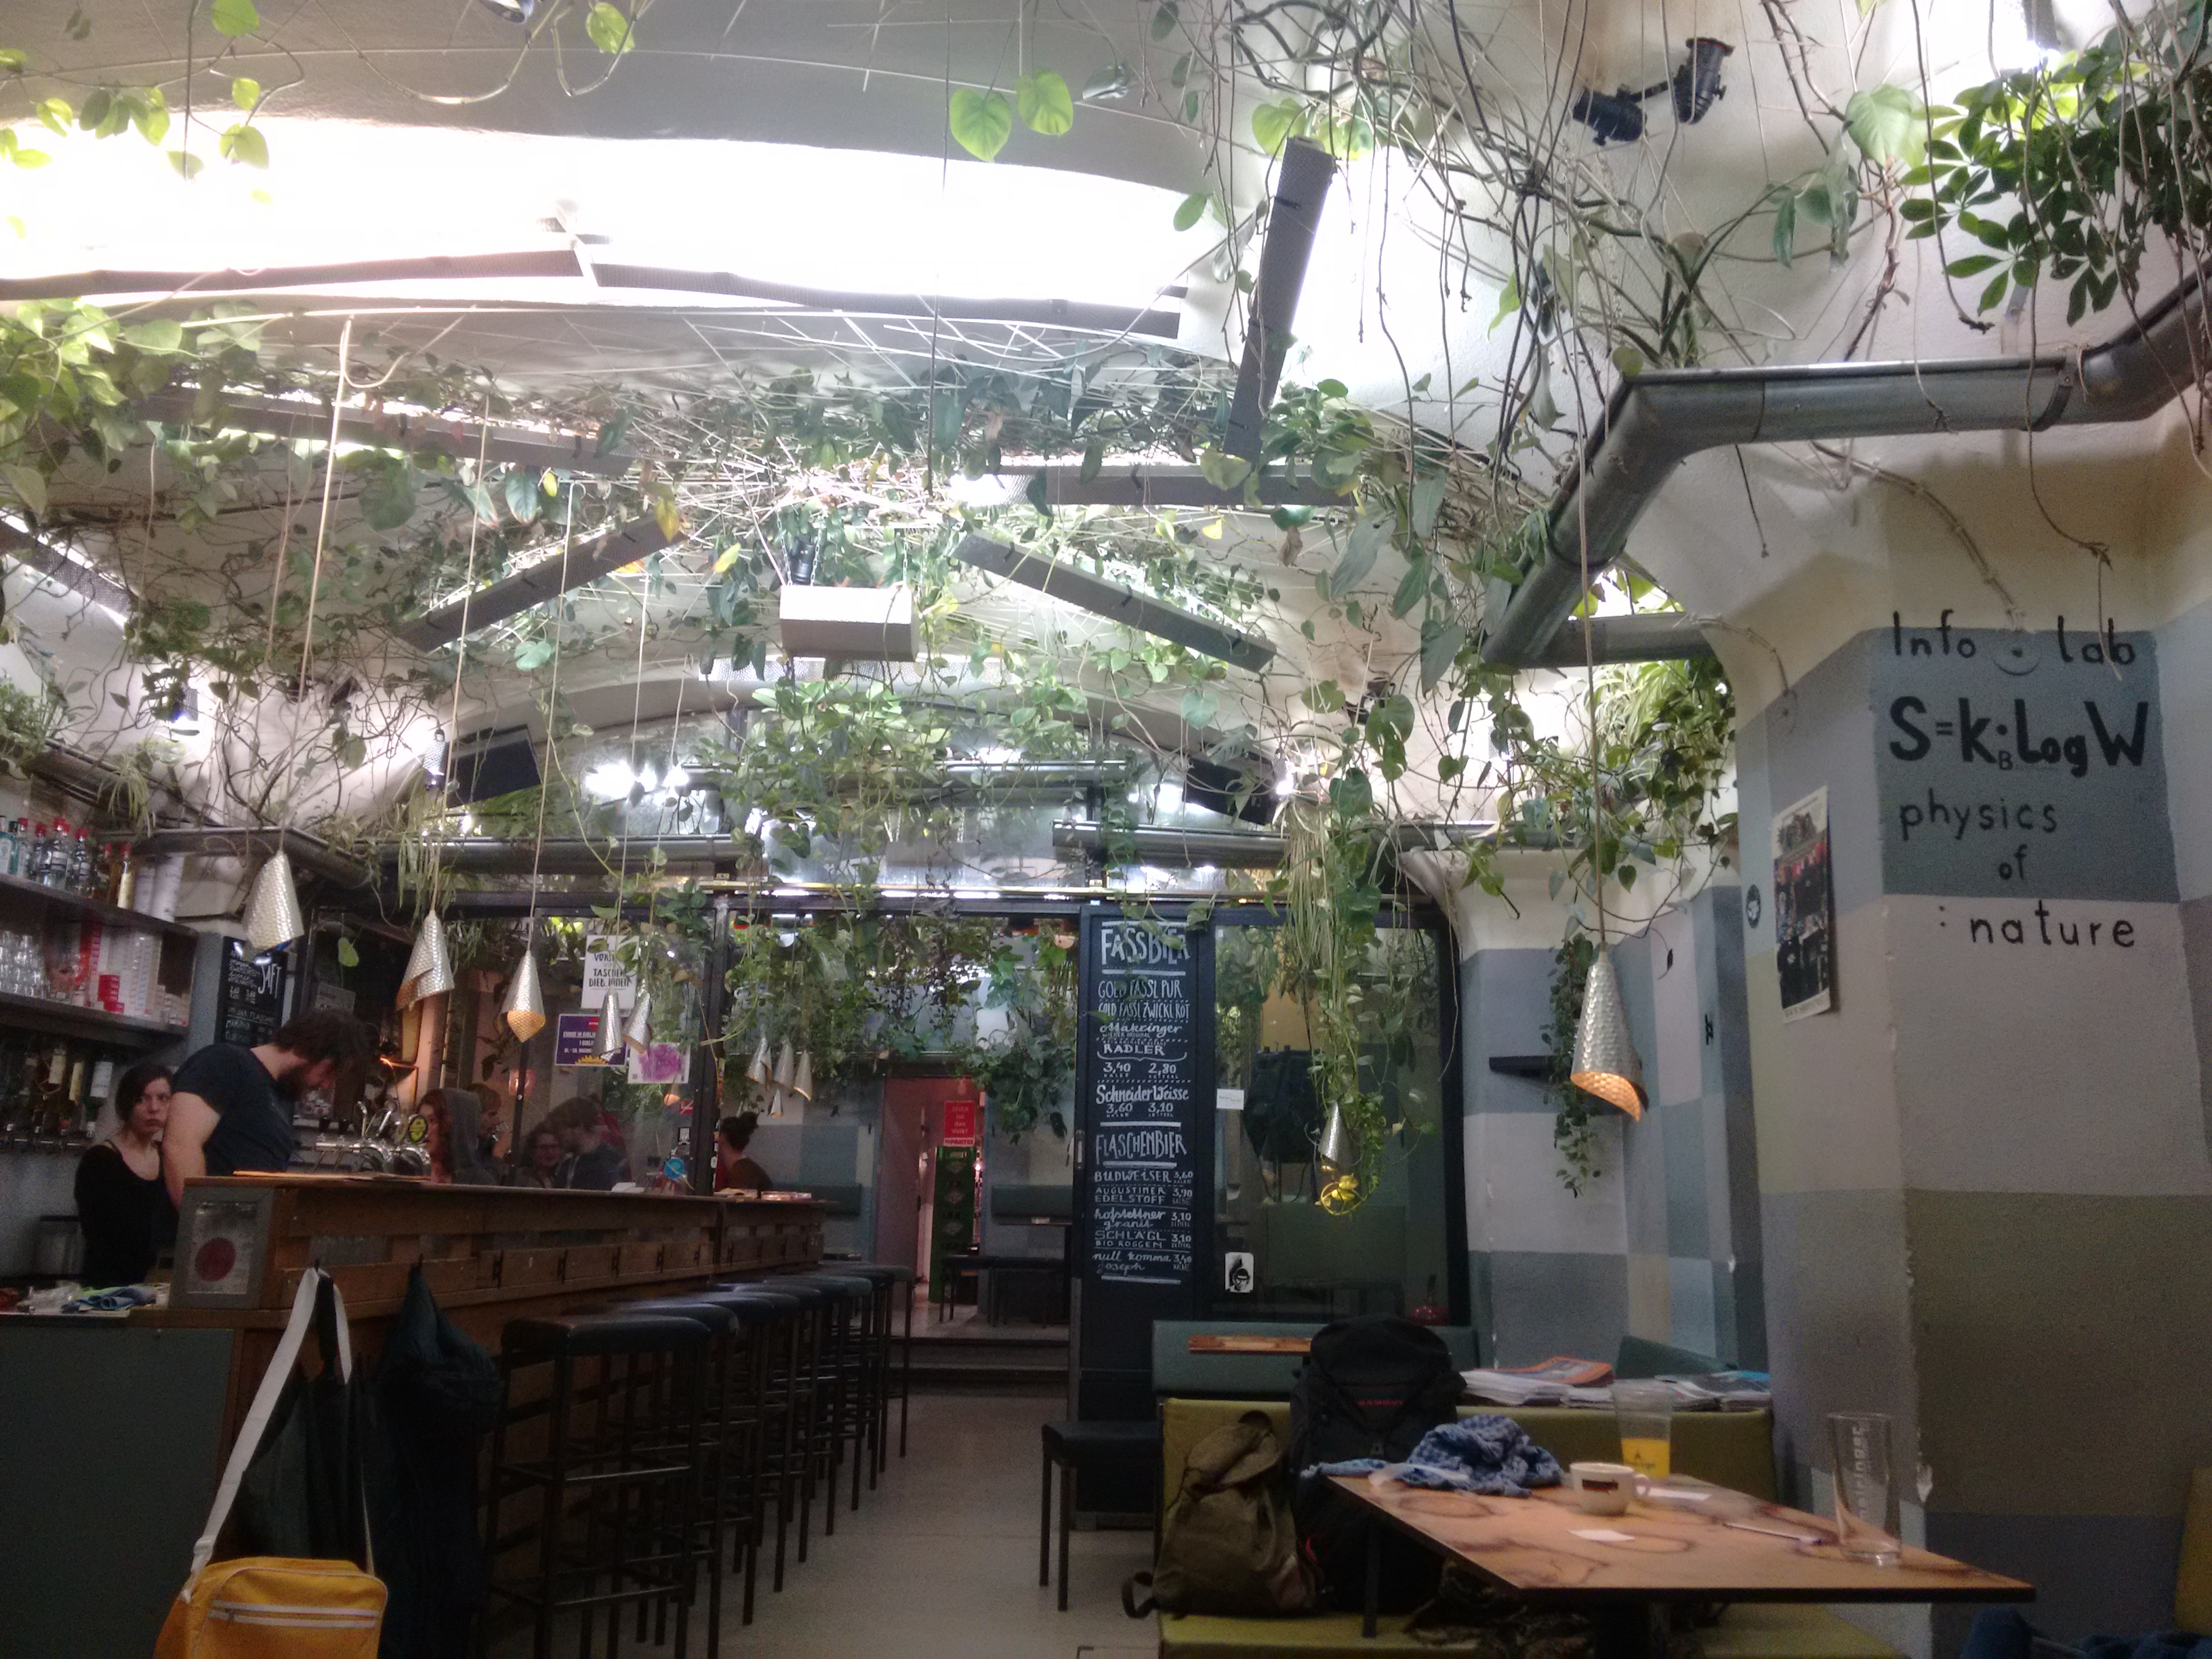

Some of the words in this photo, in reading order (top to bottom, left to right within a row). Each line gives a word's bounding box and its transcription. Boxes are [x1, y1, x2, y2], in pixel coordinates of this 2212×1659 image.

[1893, 609, 1977, 659] Info
[2057, 615, 2137, 665] lab
[1900, 787, 2058, 841] physics
[1999, 844, 2028, 881] of
[1969, 900, 2135, 948] nature
[1161, 979, 1183, 999] PUR
[1119, 1002, 1141, 1018] FASSL
[1142, 1002, 1174, 1019] ZWICKL
[1175, 1003, 1191, 1019] ROT
[1103, 1044, 1165, 1056] RADLER
[1103, 1062, 1132, 1075] 3,40
[1147, 1062, 1177, 1077] 2,80
[1095, 1084, 1153, 1105] Schneider
[1152, 1084, 1190, 1101] Weisse
[1105, 1103, 1134, 1114] 3,60
[1147, 1103, 1174, 1113] 3,10
[1095, 1129, 1187, 1165] FLASCHENBIER
[1094, 1187, 1166, 1195] AUGUSTINER
[1094, 1194, 1166, 1205] EDELSTOFF
[1170, 1212, 1192, 1223] 3,10
[1118, 1240, 1163, 1249] ROGGEN
[1171, 1233, 1192, 1244] 3,10
[1091, 1250, 1122, 1262] null
